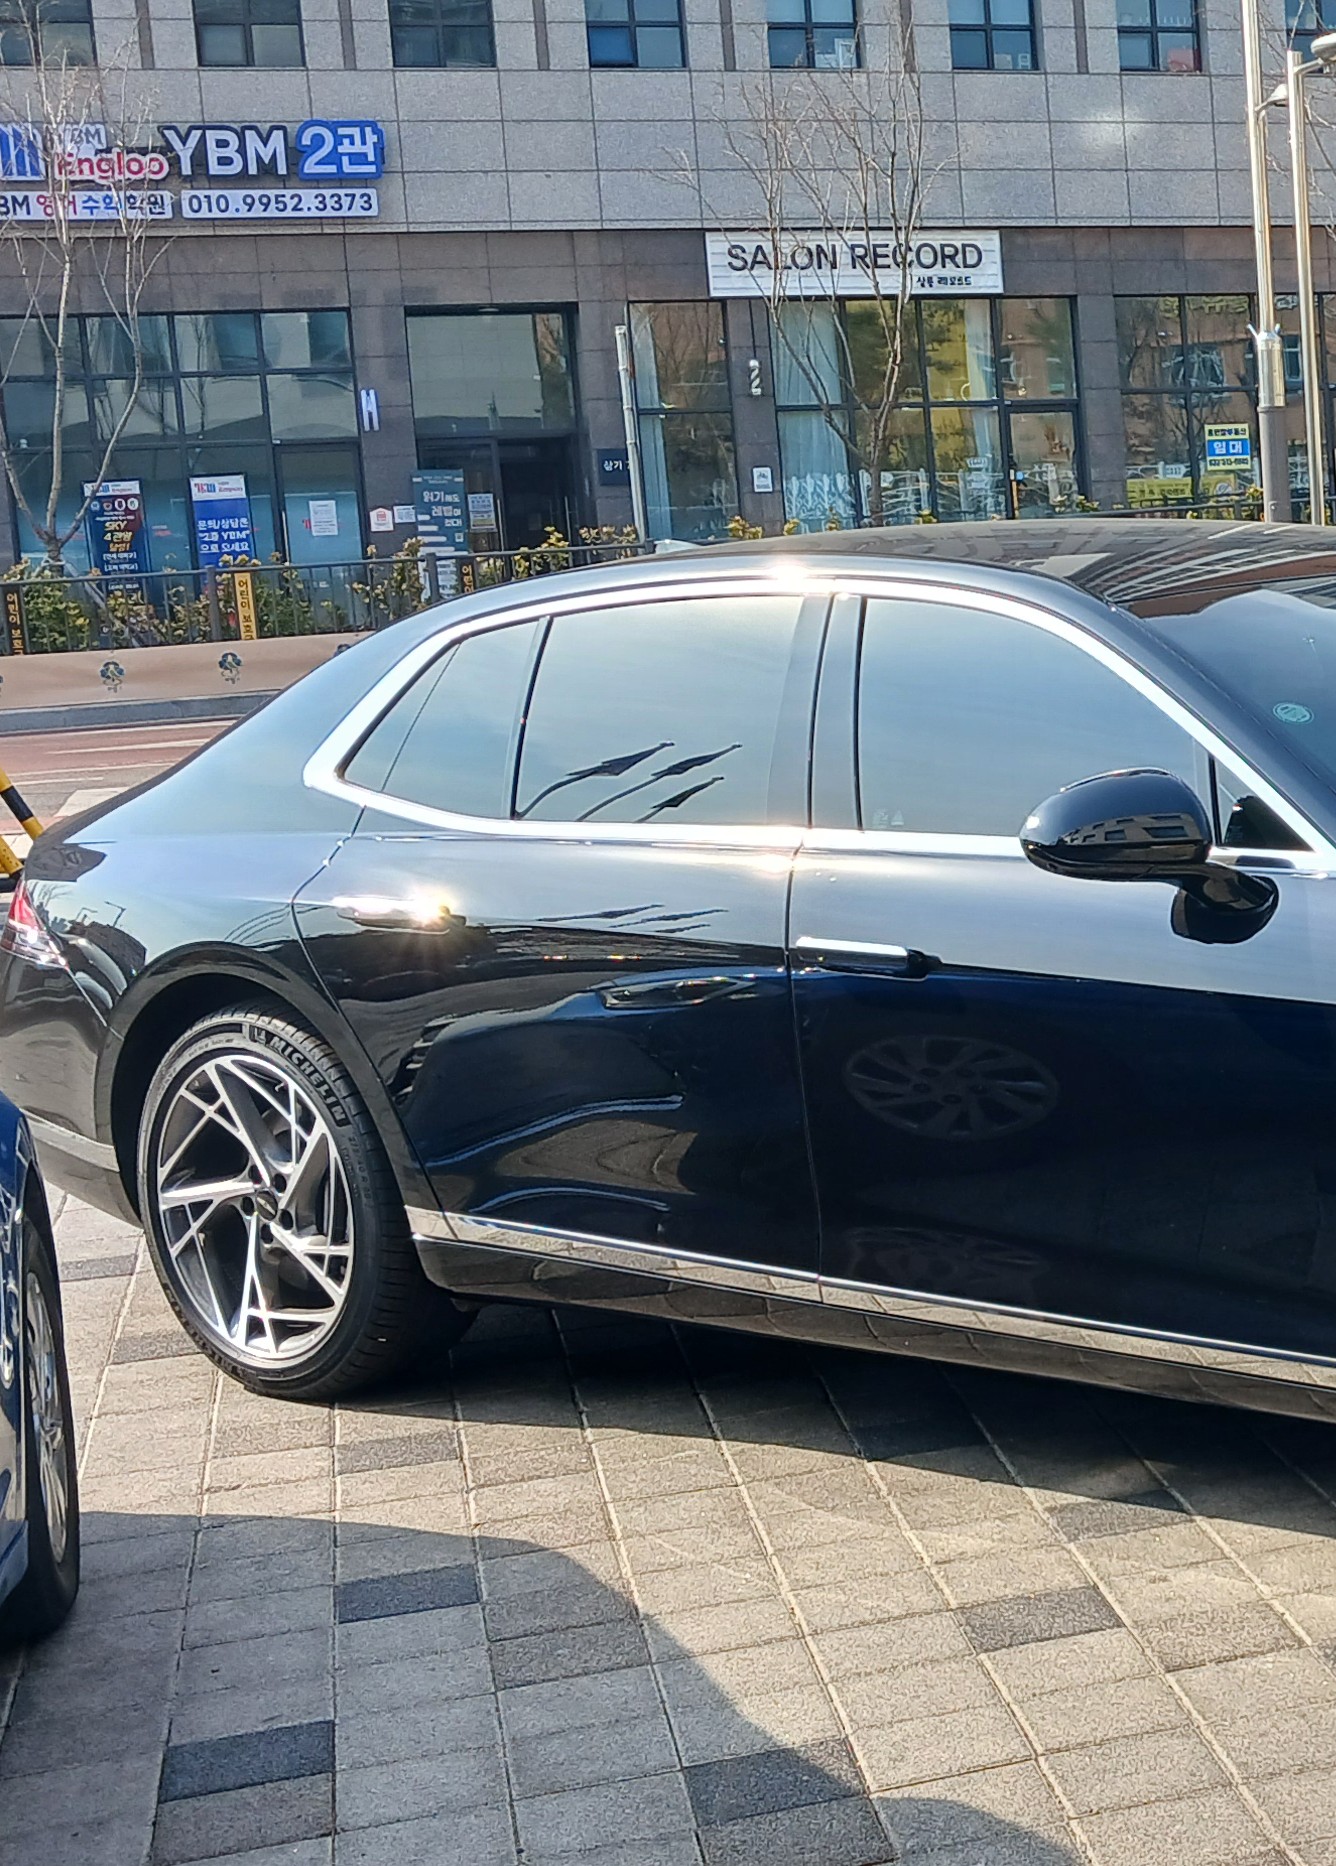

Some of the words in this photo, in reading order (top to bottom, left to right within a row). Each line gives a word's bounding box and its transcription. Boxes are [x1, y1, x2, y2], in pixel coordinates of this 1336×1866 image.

[163, 129, 288, 176] YBM
[301, 125, 378, 174] 2관
[188, 192, 373, 214] 010.9952.3373
[727, 243, 838, 272] SALON
[850, 242, 983, 270] RECORD
[104, 521, 127, 531] SKY
[6, 592, 21, 625] 어린이
[238, 578, 251, 610] 어린이
[268, 1035, 346, 1122] MICHELIN
